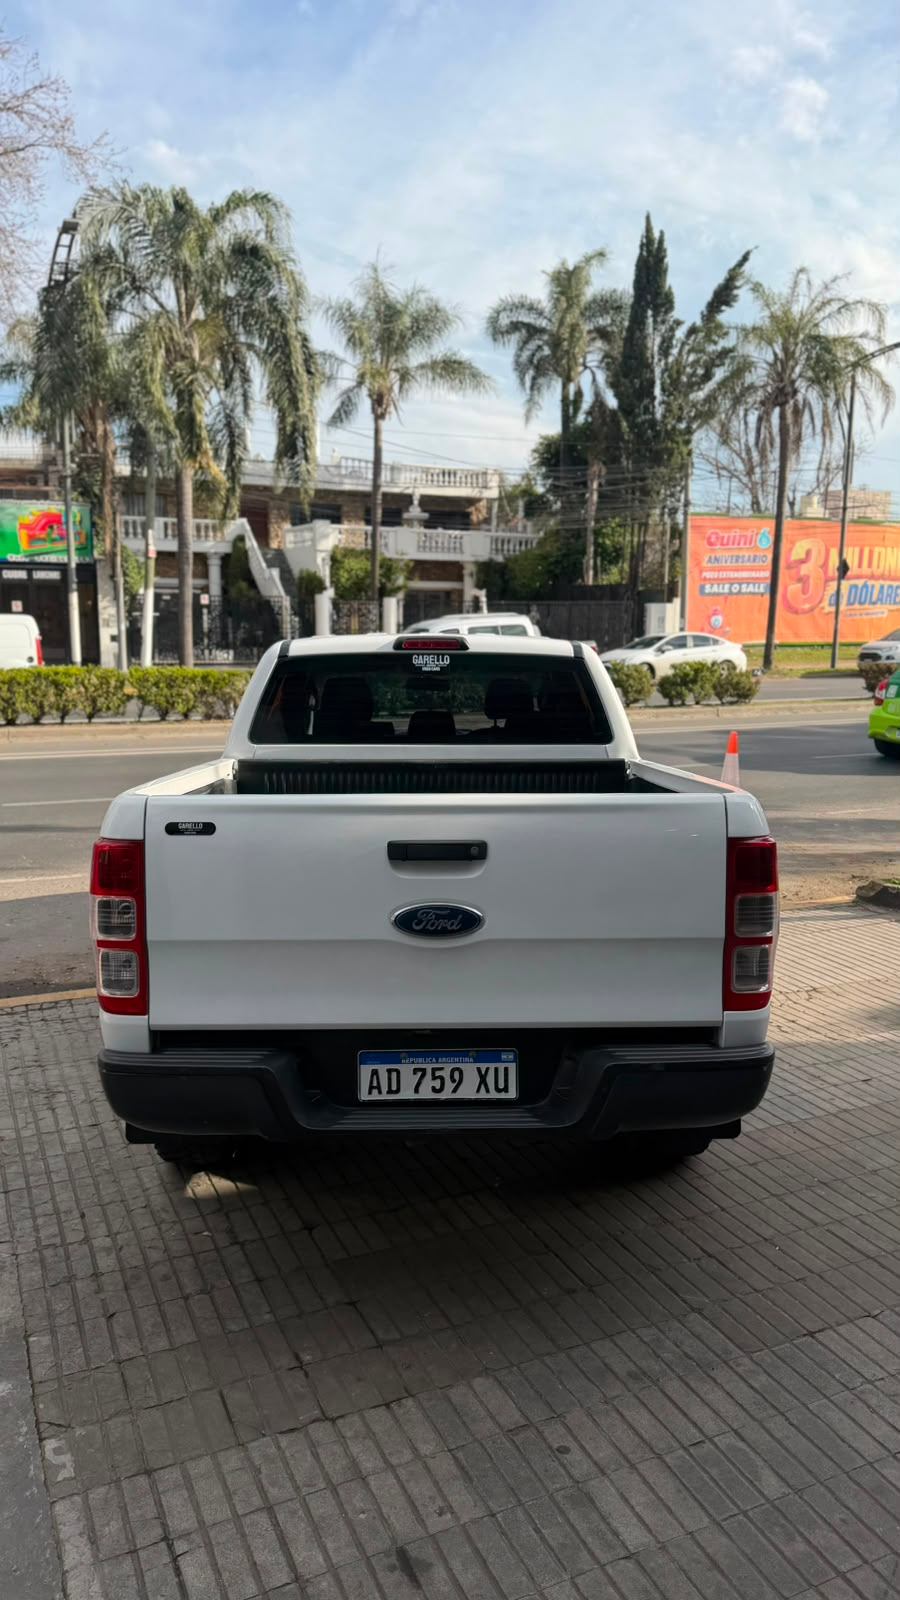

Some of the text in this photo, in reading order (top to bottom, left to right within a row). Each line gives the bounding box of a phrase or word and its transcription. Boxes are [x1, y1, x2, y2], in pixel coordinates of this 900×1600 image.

[706, 554, 768, 565] ANIVERSARIO
[786, 538, 826, 611] 3
[704, 583, 730, 593] SALE
[741, 583, 766, 593] SALE
[412, 654, 450, 665] GARELLO
[412, 909, 463, 930] Ford
[368, 1066, 510, 1095] AD 759 XU
